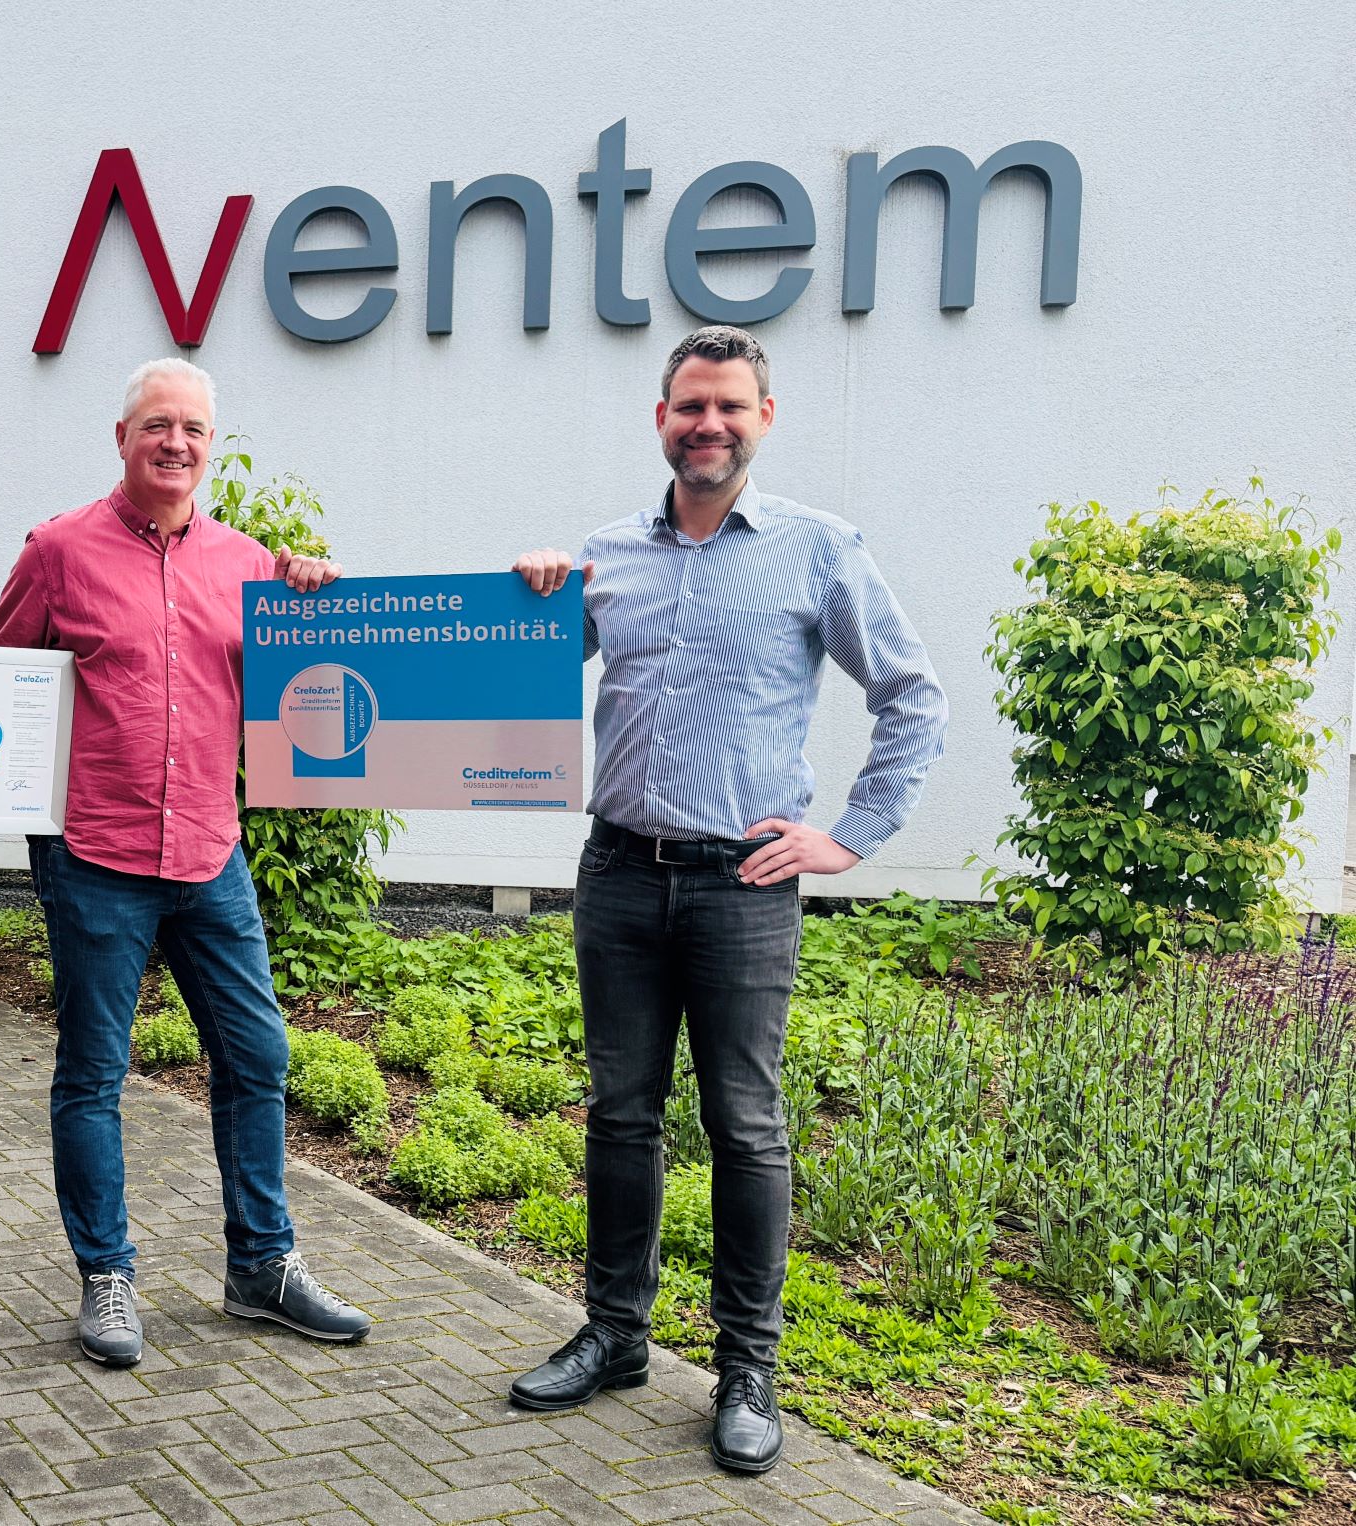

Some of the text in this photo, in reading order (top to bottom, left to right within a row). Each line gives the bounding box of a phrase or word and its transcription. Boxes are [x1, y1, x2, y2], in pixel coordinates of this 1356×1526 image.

[254, 592, 463, 620] Ausgezeichnete
[255, 619, 568, 646] Unternehmensbonität.
[293, 686, 335, 694] CrefoZert
[462, 767, 552, 780] Creditreform
[463, 781, 509, 789] DÜSSELDORF
